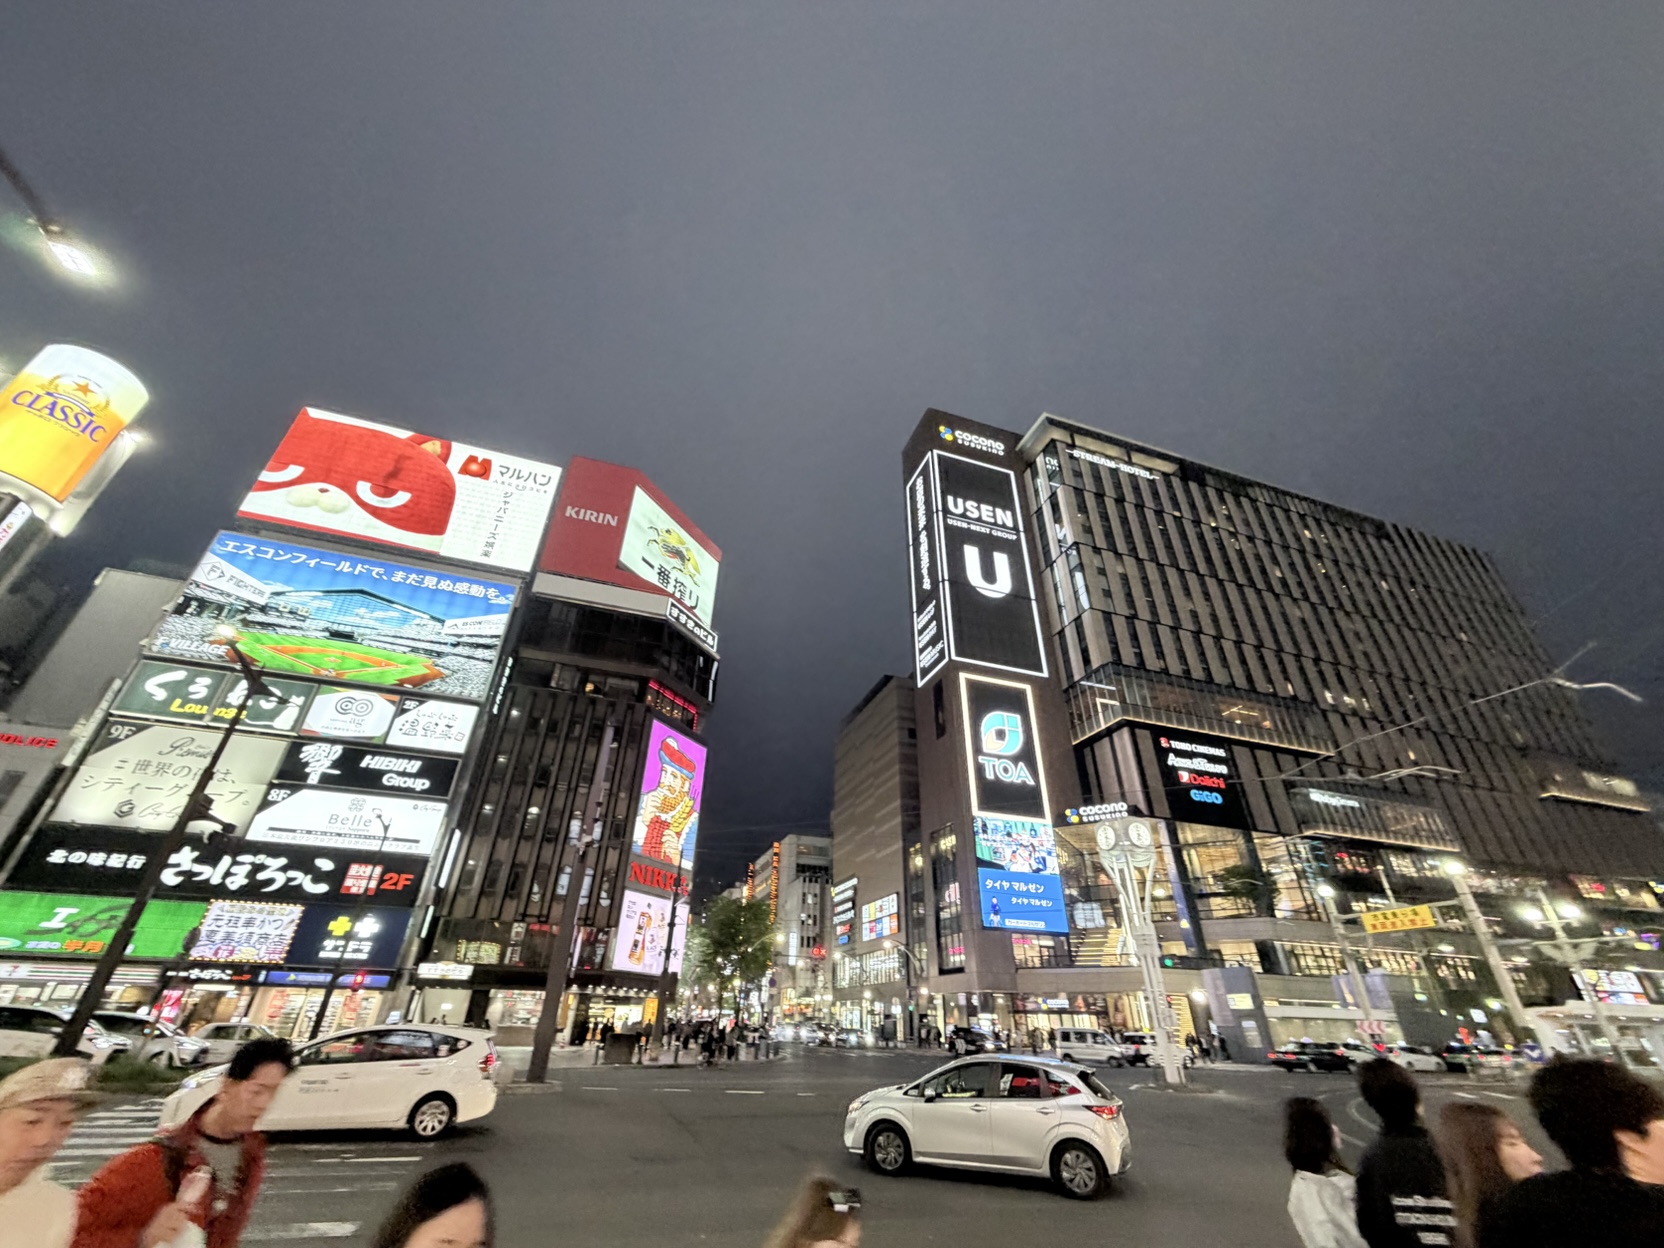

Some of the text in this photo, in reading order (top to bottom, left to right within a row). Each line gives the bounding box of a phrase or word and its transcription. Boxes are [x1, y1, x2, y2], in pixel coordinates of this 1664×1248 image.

[11, 390, 107, 443] CLASSIC
[498, 464, 552, 486] マルハン
[564, 505, 619, 526] KIRIN
[946, 494, 1014, 528] USEN
[946, 518, 1018, 541] USEN-NEXT GROUP
[963, 544, 1012, 598] U
[226, 574, 267, 599] FIGHTERS
[641, 555, 700, 611] 一番搾り
[670, 606, 715, 646] すすきのビル
[169, 638, 230, 655] VILLAGE
[109, 724, 137, 739] 9F
[1169, 740, 1192, 751] TOHO
[359, 755, 422, 773] HIBIKI
[978, 755, 1036, 785] TOA
[81, 775, 250, 806] シティーグープ。
[381, 773, 430, 791] Group
[269, 788, 291, 801] 8F
[328, 813, 373, 828] Belle
[47, 848, 147, 869] 北の味紀行
[159, 846, 335, 894] さっぽろっこ
[380, 872, 414, 891] 2F
[985, 878, 1045, 893] タイヤ マルゼン
[1011, 896, 1053, 907] タイヤ マルゼン
